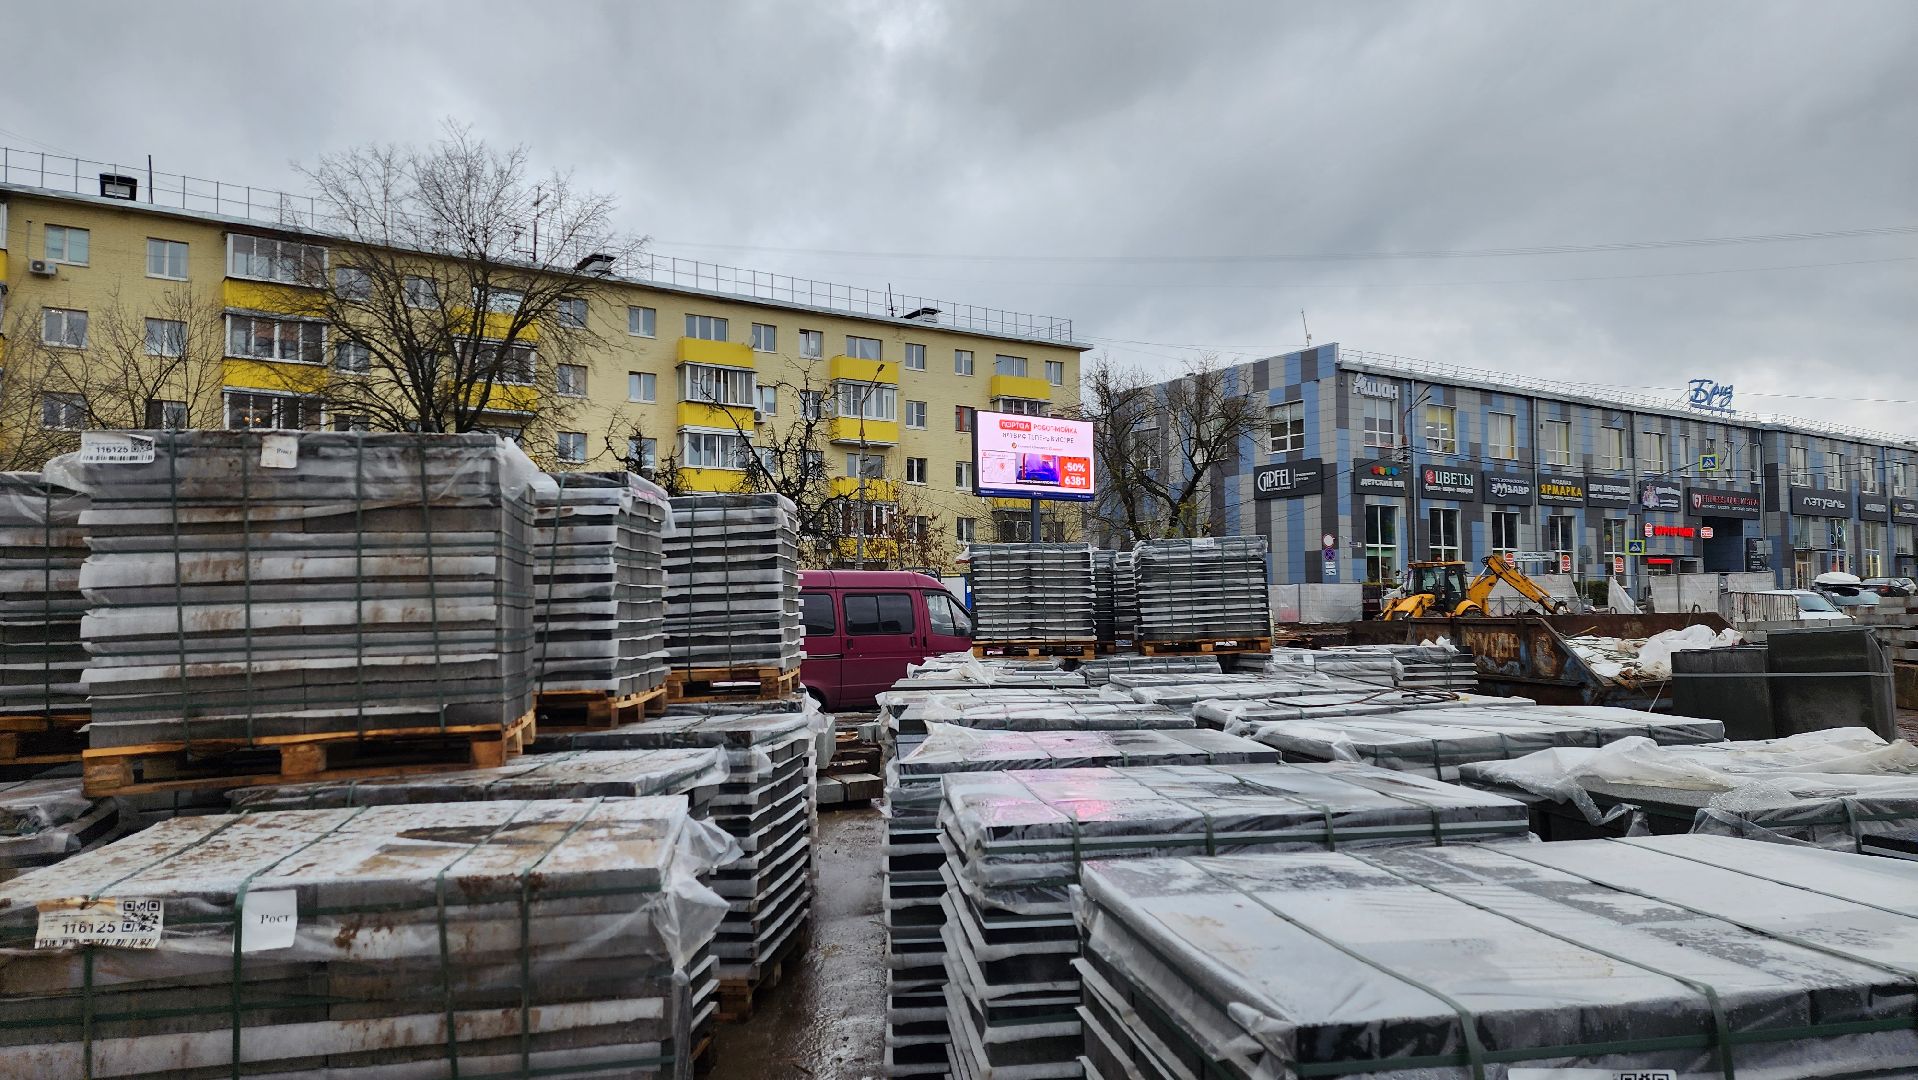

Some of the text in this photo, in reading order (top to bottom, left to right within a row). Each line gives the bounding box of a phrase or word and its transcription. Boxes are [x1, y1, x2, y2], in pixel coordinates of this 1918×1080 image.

[1690, 379, 1733, 407] Бриз
[1001, 421, 1030, 430] ПОРТАЛ
[1064, 462, 1085, 473] -50%
[1435, 471, 1474, 486] ЦВЕТЫ
[1541, 484, 1583, 497] ЯРМАРКА
[261, 914, 290, 924] Рост
[63, 922, 115, 934] 116125
